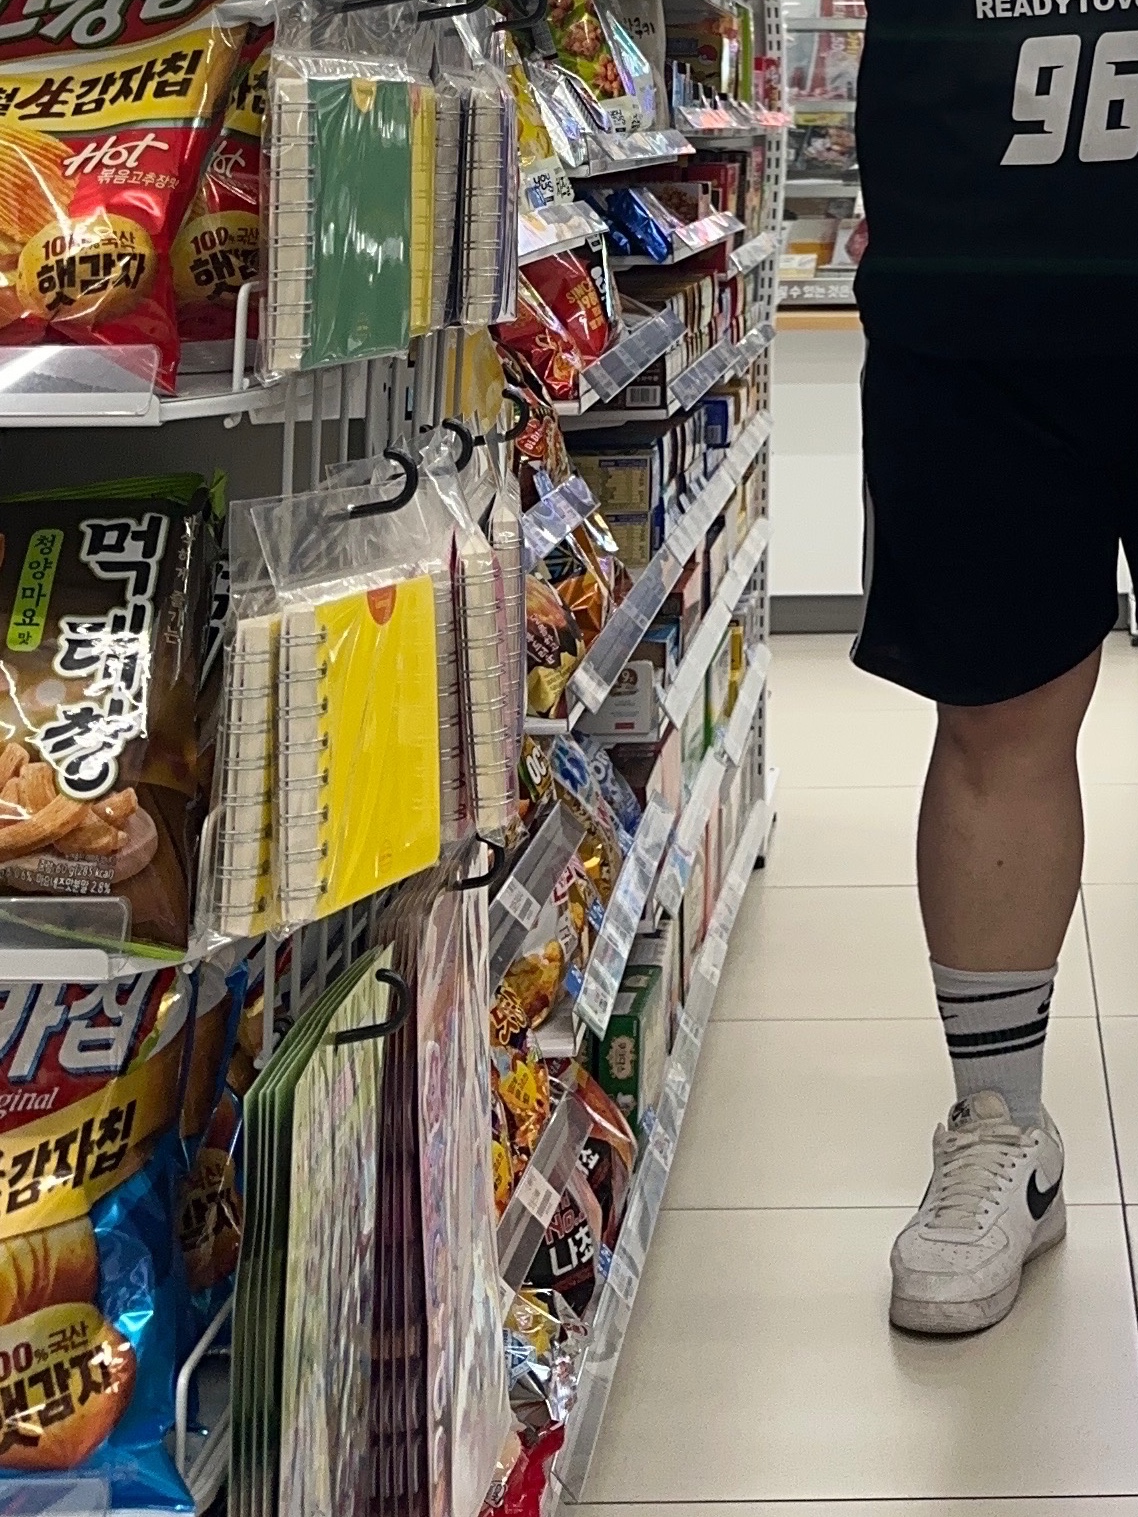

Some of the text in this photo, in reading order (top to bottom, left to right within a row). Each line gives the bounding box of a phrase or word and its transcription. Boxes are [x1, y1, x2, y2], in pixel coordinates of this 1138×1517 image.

[62, 132, 170, 178] Hot
[36, 251, 147, 312] 햇감자
[48, 1320, 89, 1354] 국산
